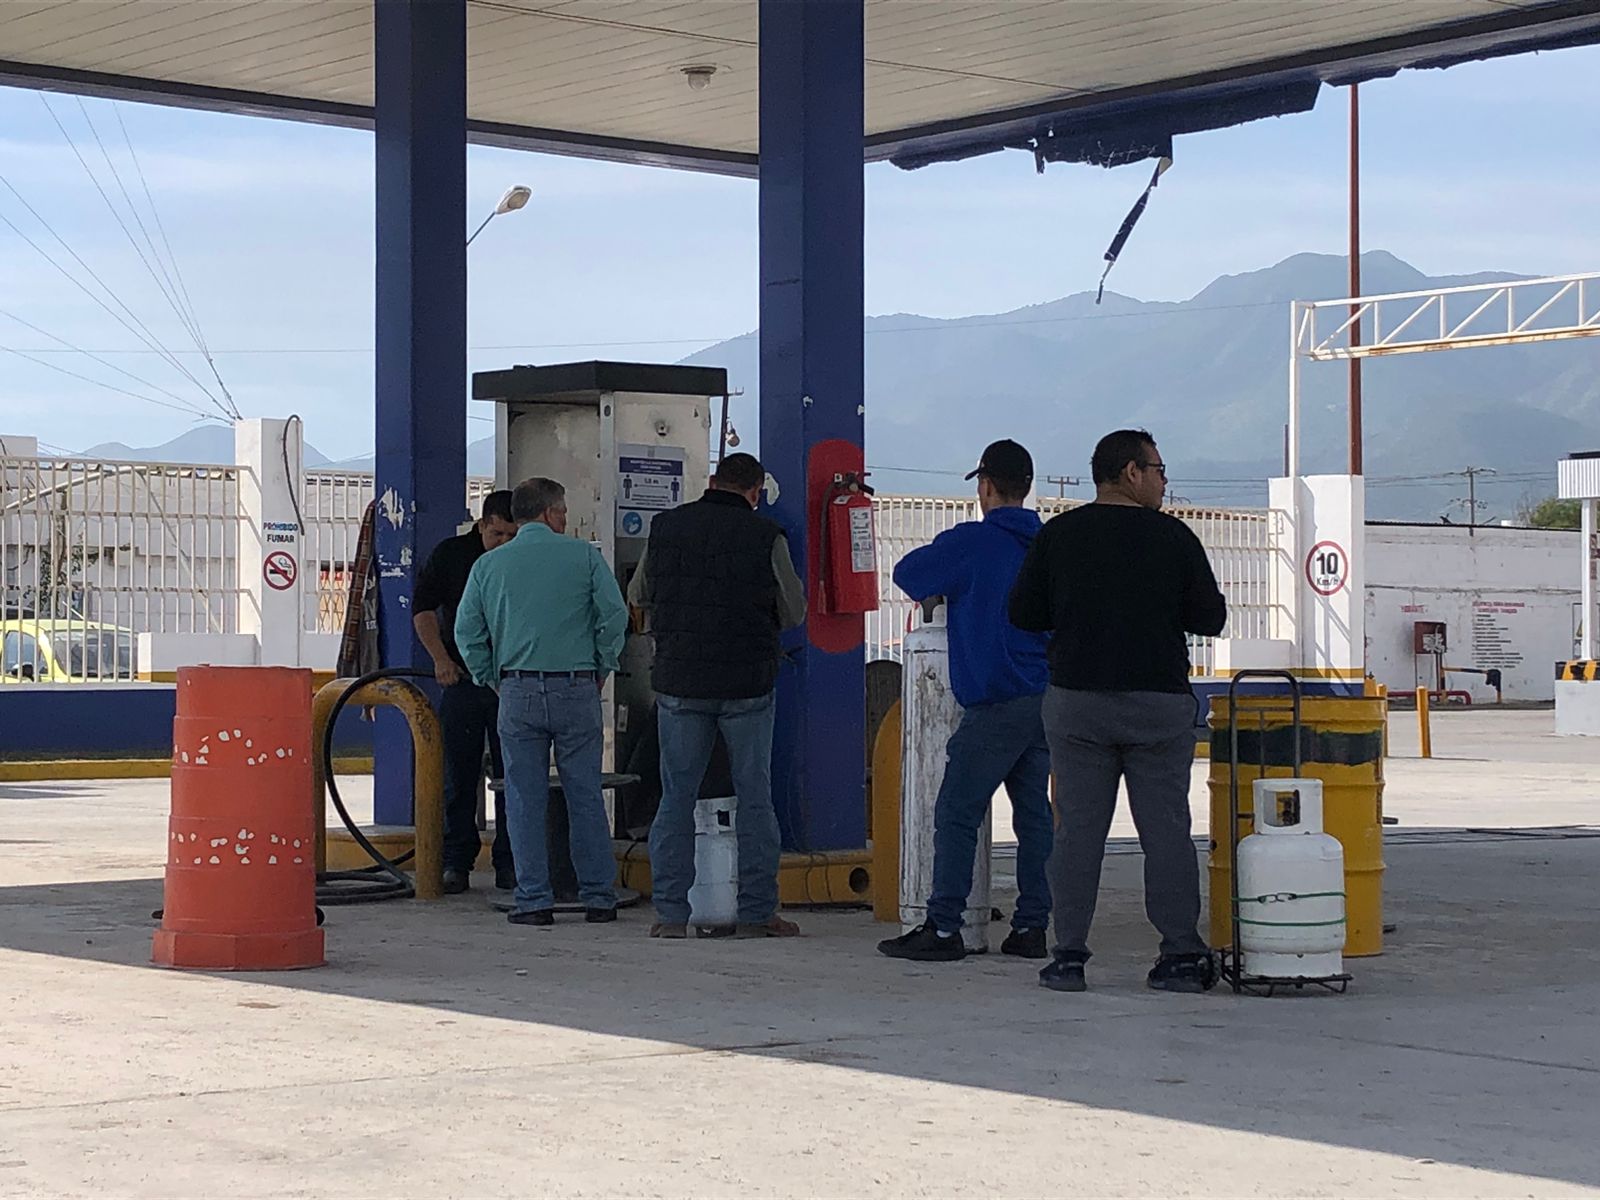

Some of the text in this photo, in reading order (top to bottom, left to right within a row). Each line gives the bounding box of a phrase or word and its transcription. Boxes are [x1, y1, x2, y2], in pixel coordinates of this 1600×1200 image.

[263, 522, 299, 531] PROHIBIDO
[266, 533, 295, 543] FUMAR
[1316, 552, 1339, 575] 10
